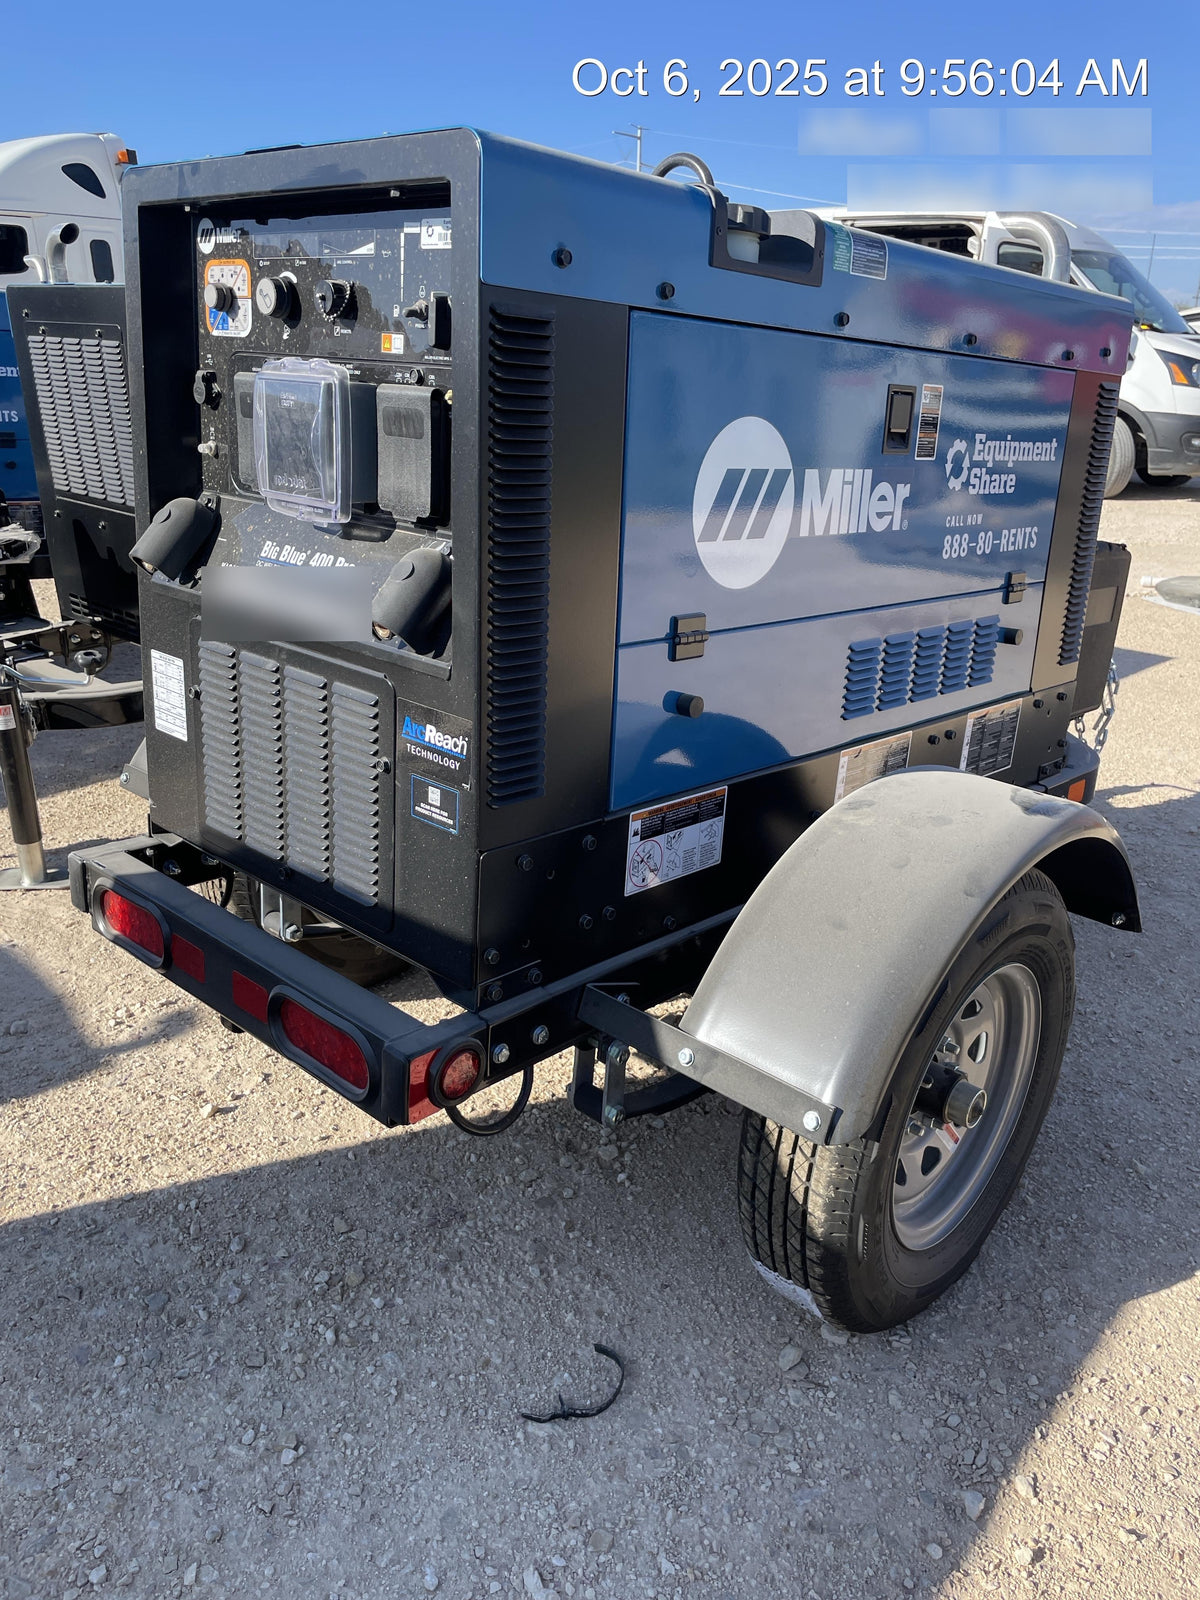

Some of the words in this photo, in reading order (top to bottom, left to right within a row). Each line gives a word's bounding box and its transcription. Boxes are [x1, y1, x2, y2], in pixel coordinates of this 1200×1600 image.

[216, 227, 242, 244] Miller
[0, 366, 19, 377] en
[0, 410, 19, 422] TS
[972, 433, 1058, 468] Equipment
[968, 467, 1017, 495] Share
[800, 468, 911, 537] Miller
[945, 514, 964, 528] CALL
[966, 513, 984, 526] NOW
[260, 541, 279, 558] Big
[280, 544, 307, 566] Blue
[942, 525, 1039, 560] 888-80-RENTS
[402, 716, 468, 756] ArcReach
[406, 743, 460, 770] TECHNOLOGY
